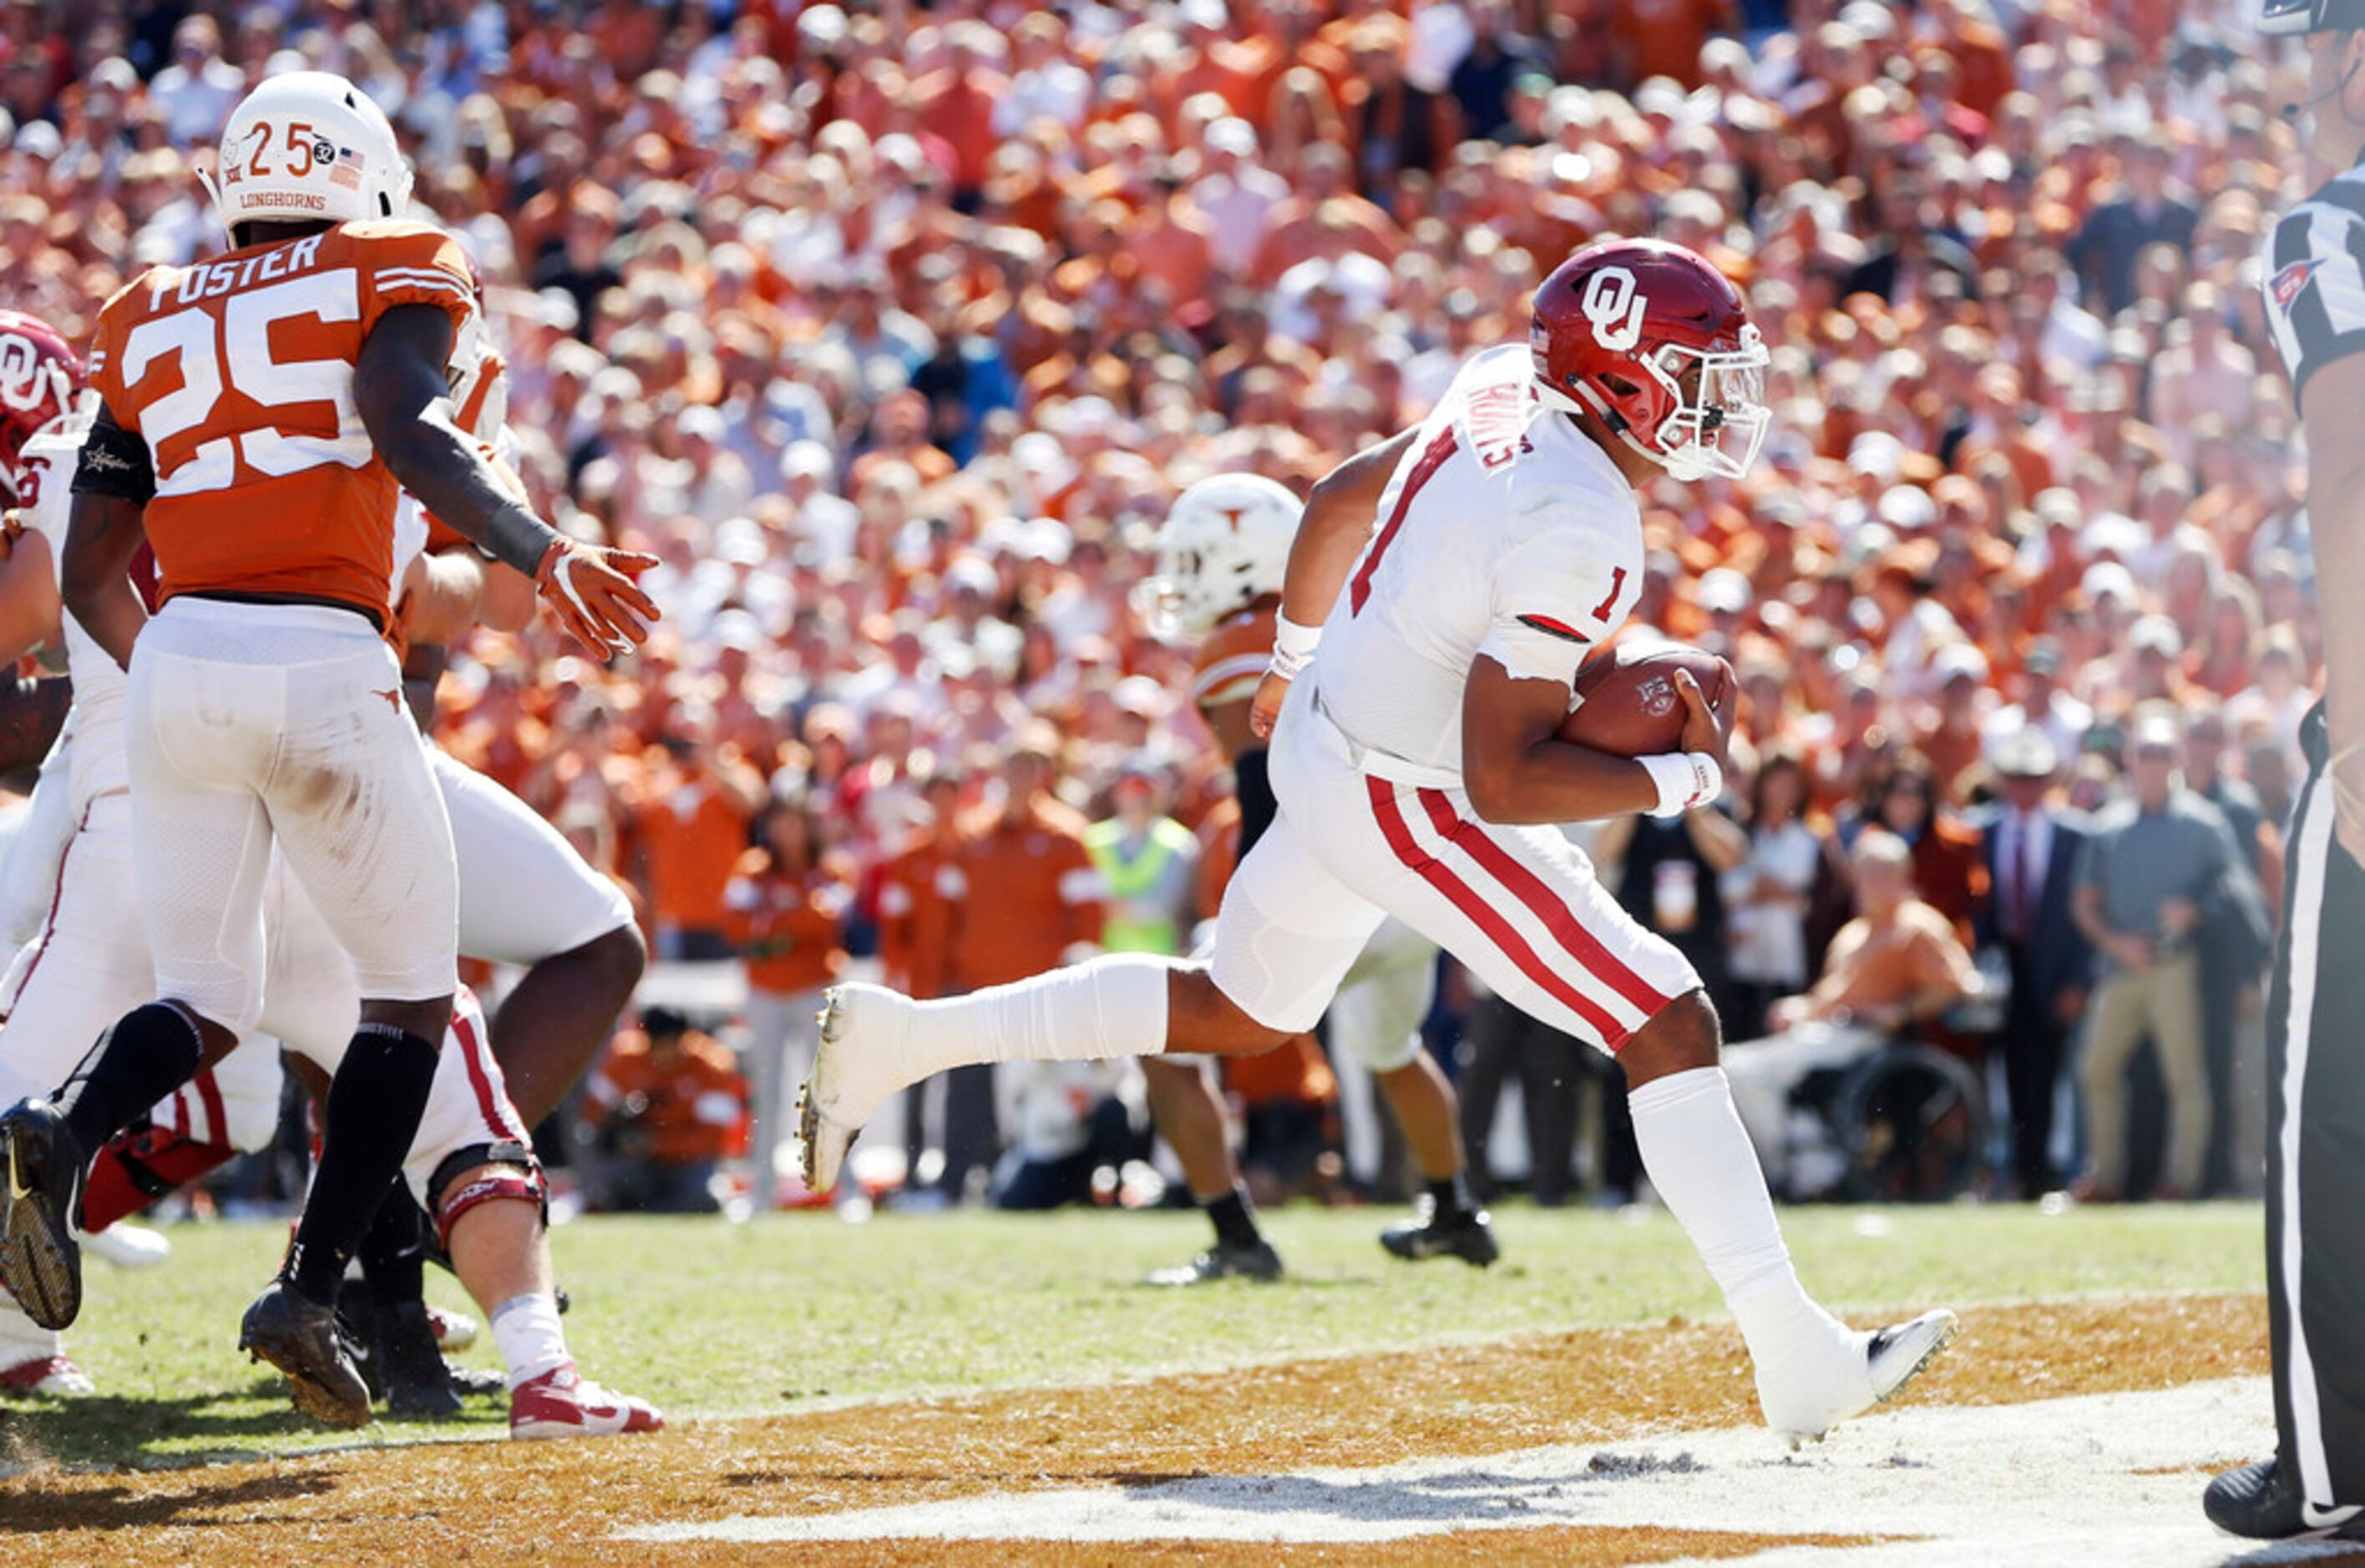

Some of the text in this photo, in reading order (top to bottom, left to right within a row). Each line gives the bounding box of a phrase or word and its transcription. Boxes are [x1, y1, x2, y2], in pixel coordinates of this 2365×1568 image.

[250, 121, 313, 177] 25
[317, 144, 333, 163] 32
[240, 191, 327, 210] LONGHORNS
[149, 233, 324, 313] FOSTER
[1581, 266, 1648, 352] OU
[121, 267, 374, 498] 25
[1350, 424, 1460, 619] 1
[1591, 565, 1627, 624] 1
